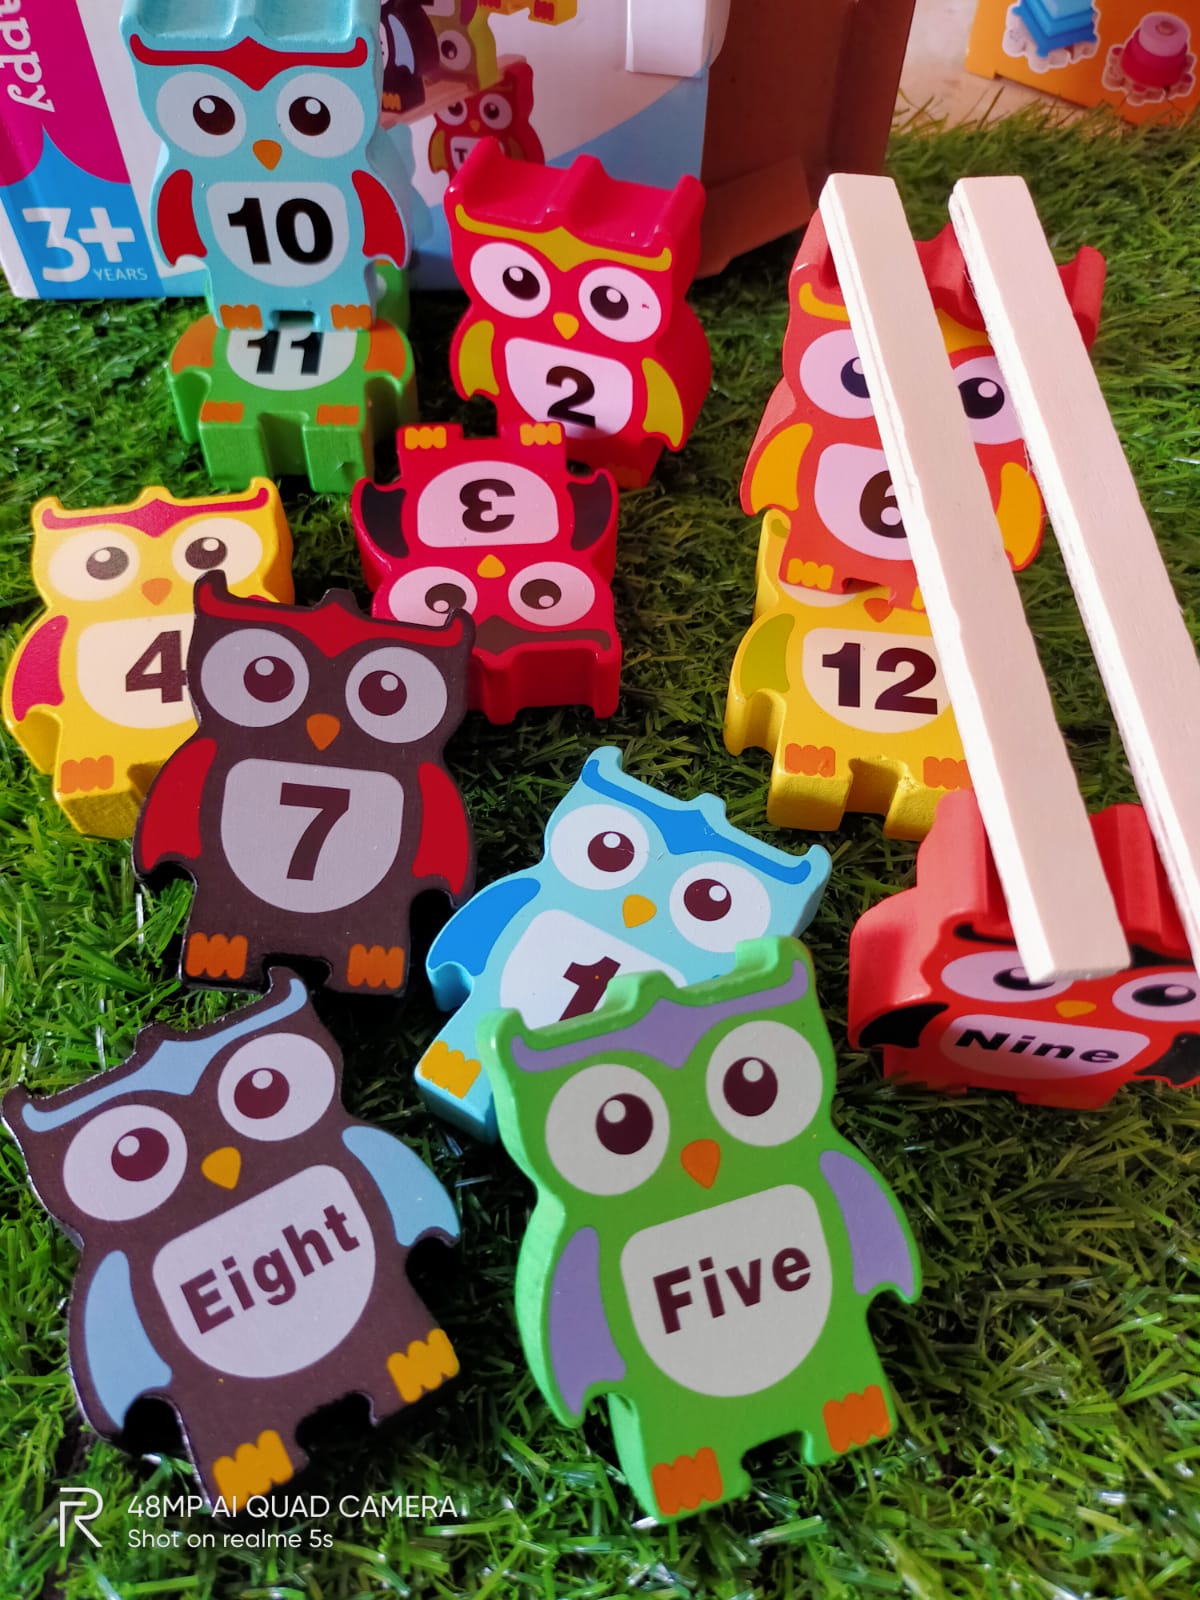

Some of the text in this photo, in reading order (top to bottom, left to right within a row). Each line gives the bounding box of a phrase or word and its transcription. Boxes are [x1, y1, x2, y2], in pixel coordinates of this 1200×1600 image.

[22, 207, 136, 283] 3+
[227, 197, 334, 265] 10
[93, 267, 149, 281] YEARS
[247, 330, 325, 376] 11
[545, 365, 596, 429] 2
[459, 478, 516, 534] 3
[859, 469, 909, 539] 6
[125, 629, 188, 704] 4
[822, 641, 939, 716] 12
[279, 782, 351, 882] 7
[558, 955, 622, 1022] 1
[954, 1028, 1120, 1064] Nine
[180, 1204, 361, 1335] Eight
[652, 1247, 811, 1335] Five
